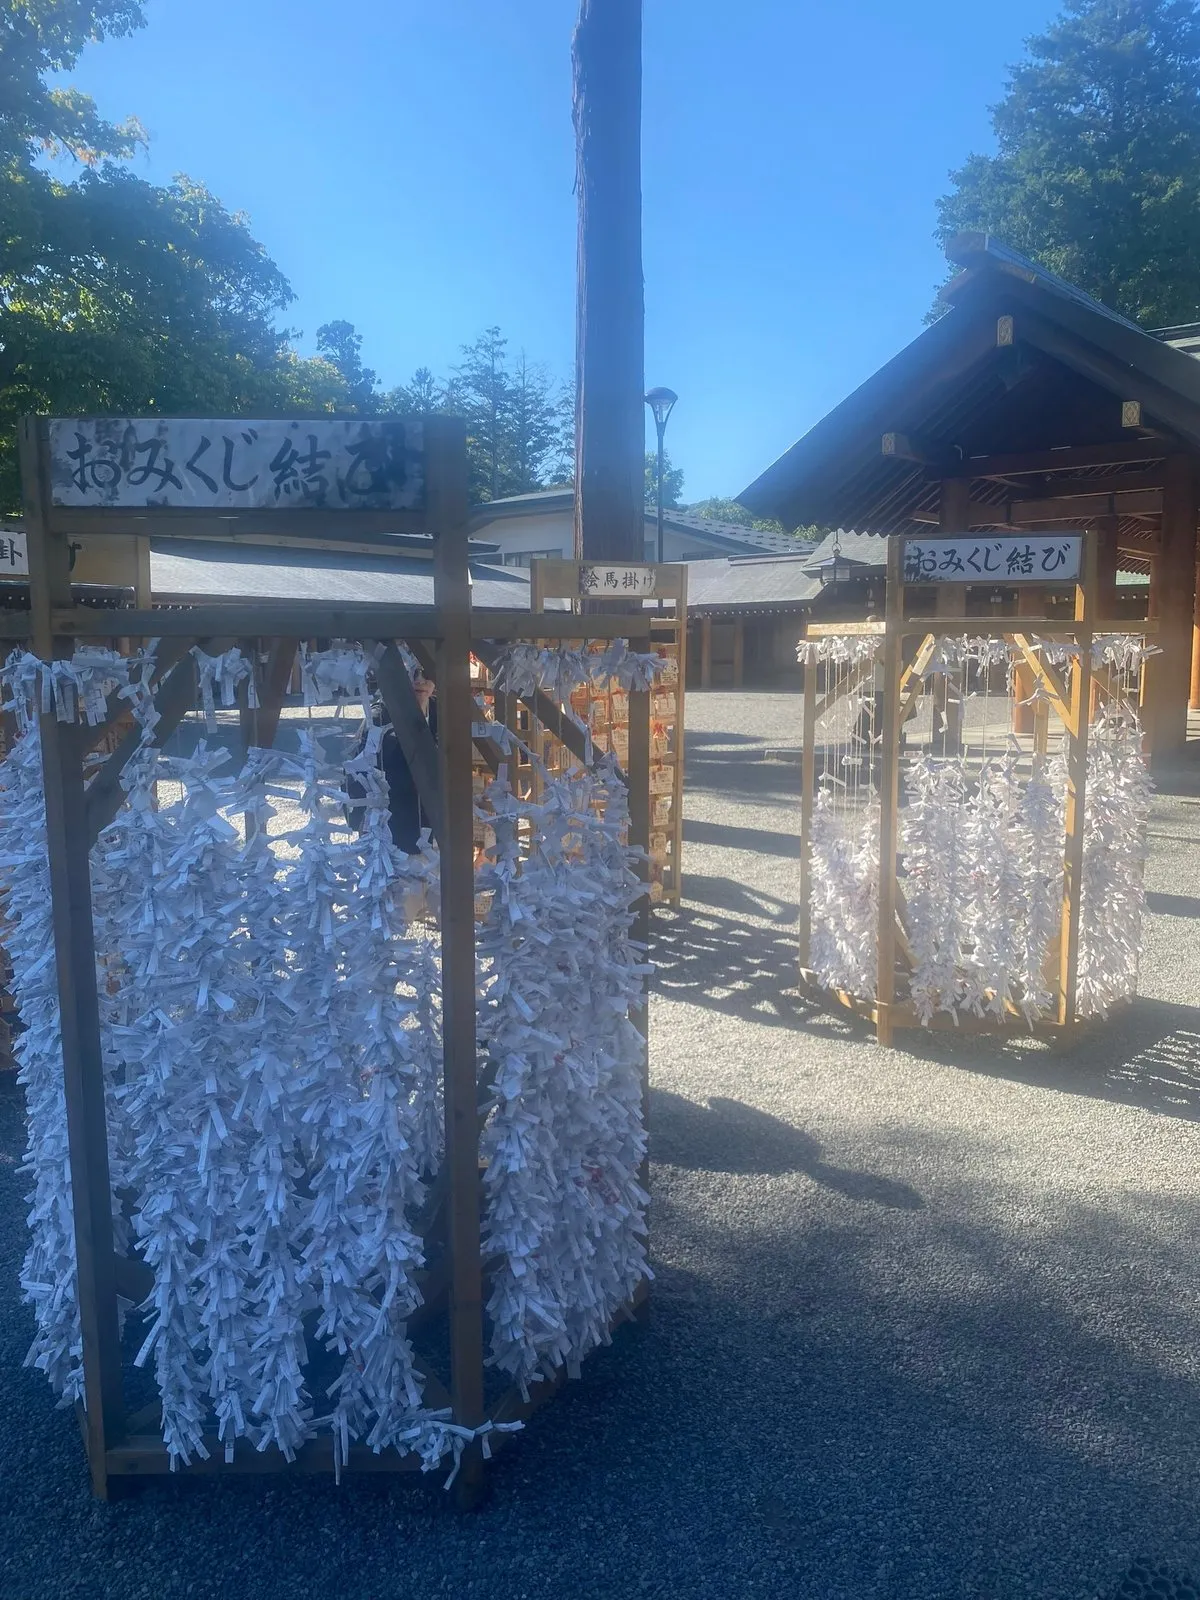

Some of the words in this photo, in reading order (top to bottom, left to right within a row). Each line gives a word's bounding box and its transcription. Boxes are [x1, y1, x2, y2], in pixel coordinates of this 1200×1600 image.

[914, 543, 1071, 576] おみくじ結び
[584, 571, 656, 590] 絵馬掛け
